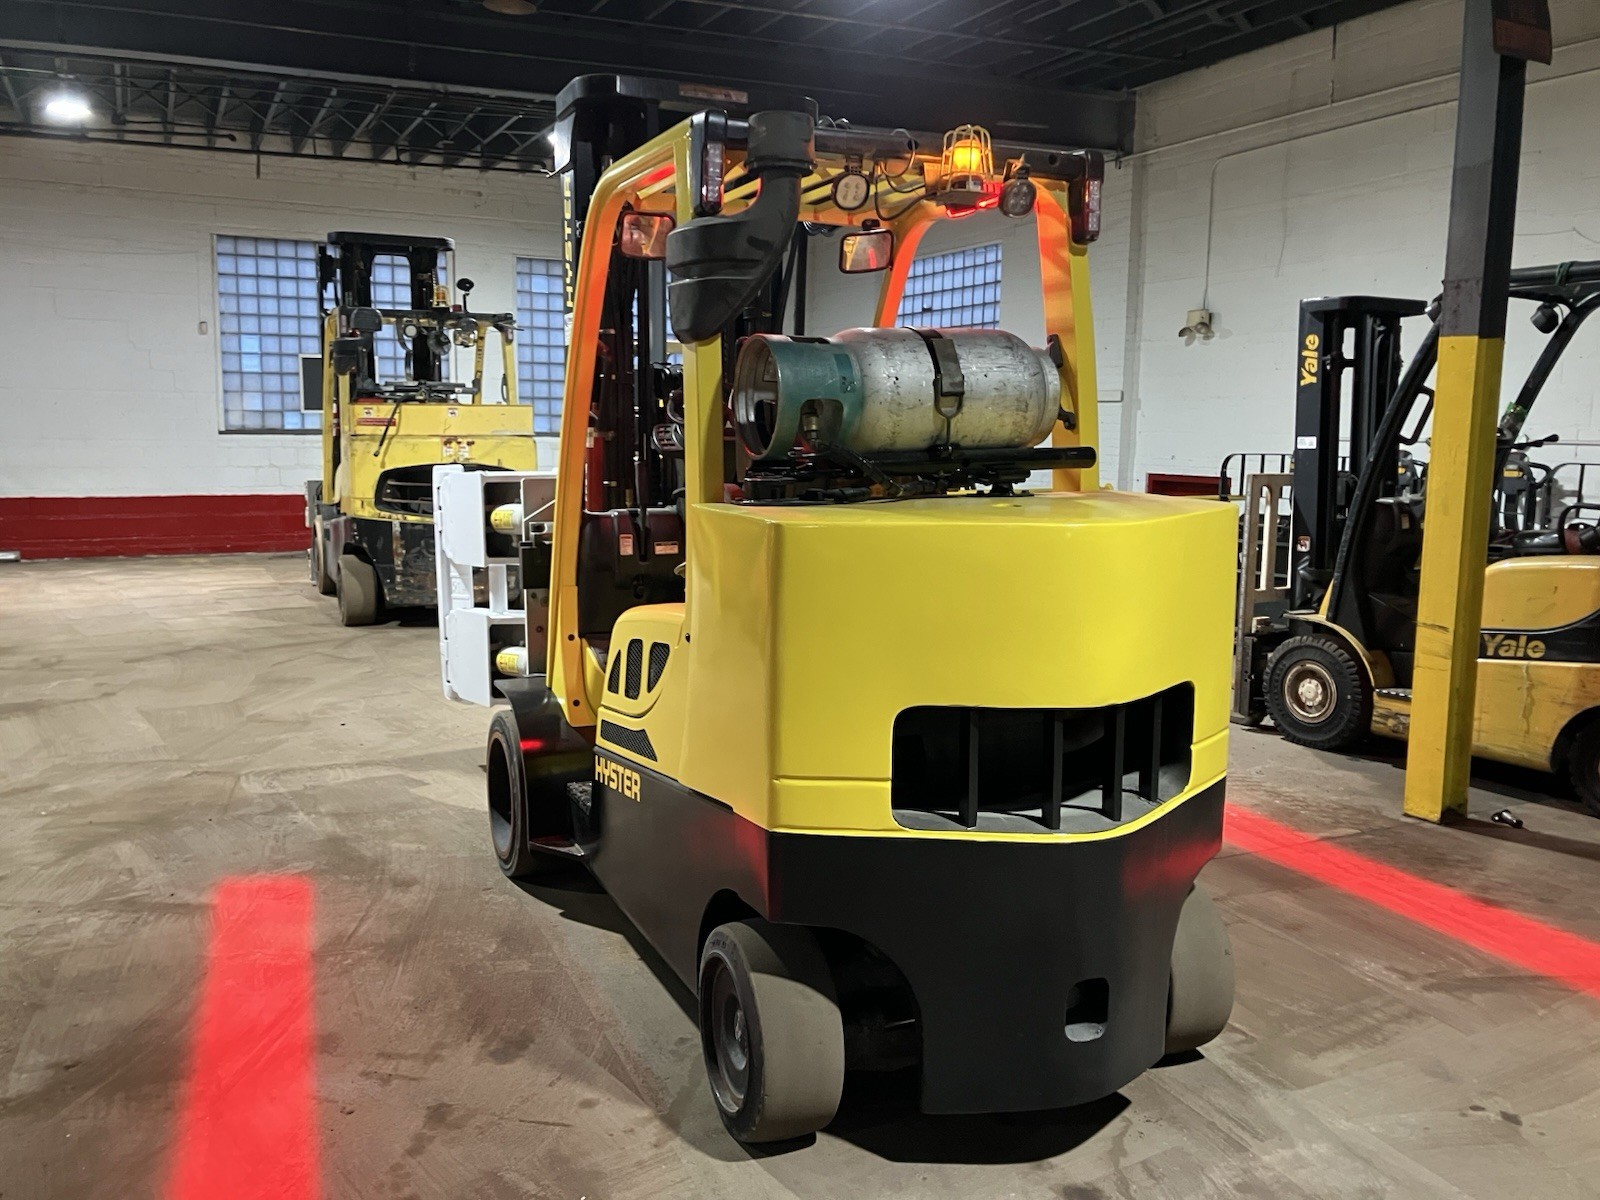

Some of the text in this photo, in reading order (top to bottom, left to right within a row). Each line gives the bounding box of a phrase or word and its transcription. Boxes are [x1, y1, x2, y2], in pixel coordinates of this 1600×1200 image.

[563, 175, 574, 308] HYSTER
[1300, 333, 1320, 386] Yale
[1482, 633, 1546, 659] Yale
[595, 754, 641, 803] HYSTER
